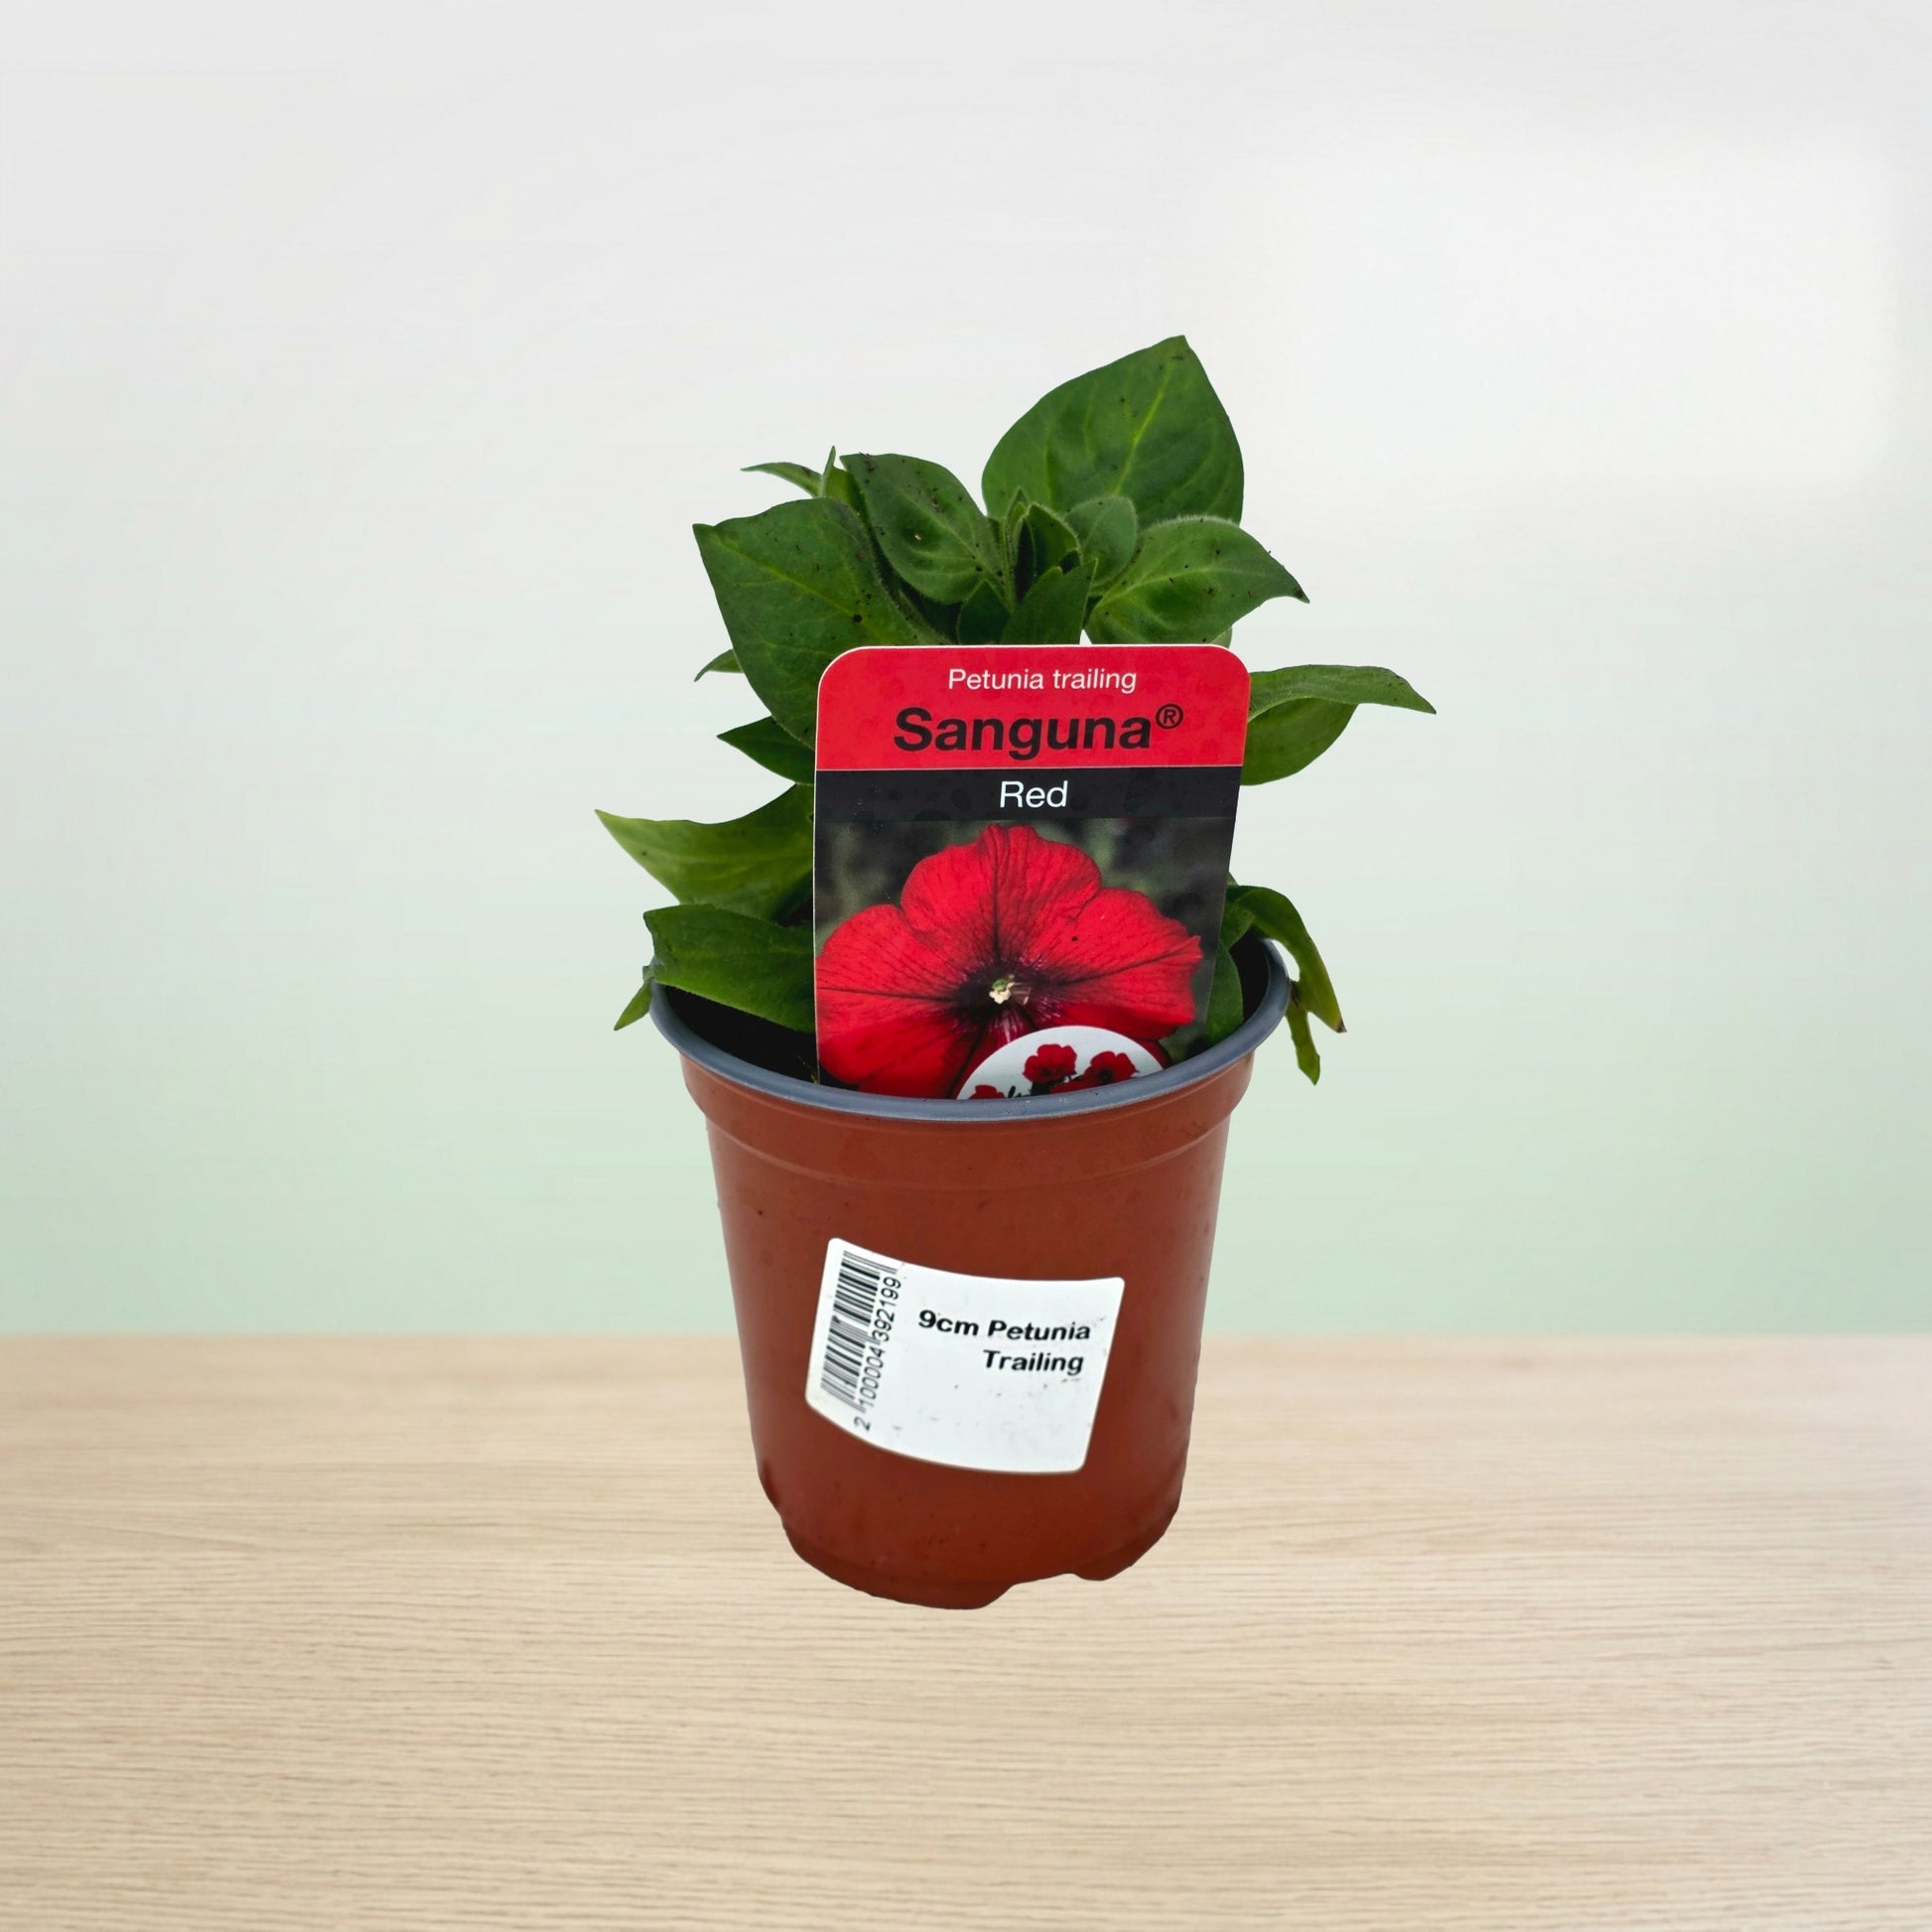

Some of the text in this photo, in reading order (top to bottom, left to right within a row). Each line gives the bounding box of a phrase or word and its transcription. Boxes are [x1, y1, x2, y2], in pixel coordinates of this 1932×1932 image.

[948, 668, 1137, 694] Petunia trailing
[999, 780, 1068, 808] Red
[918, 1310, 1091, 1341] 9cm Petunia
[982, 1349, 1084, 1376] Trailing
